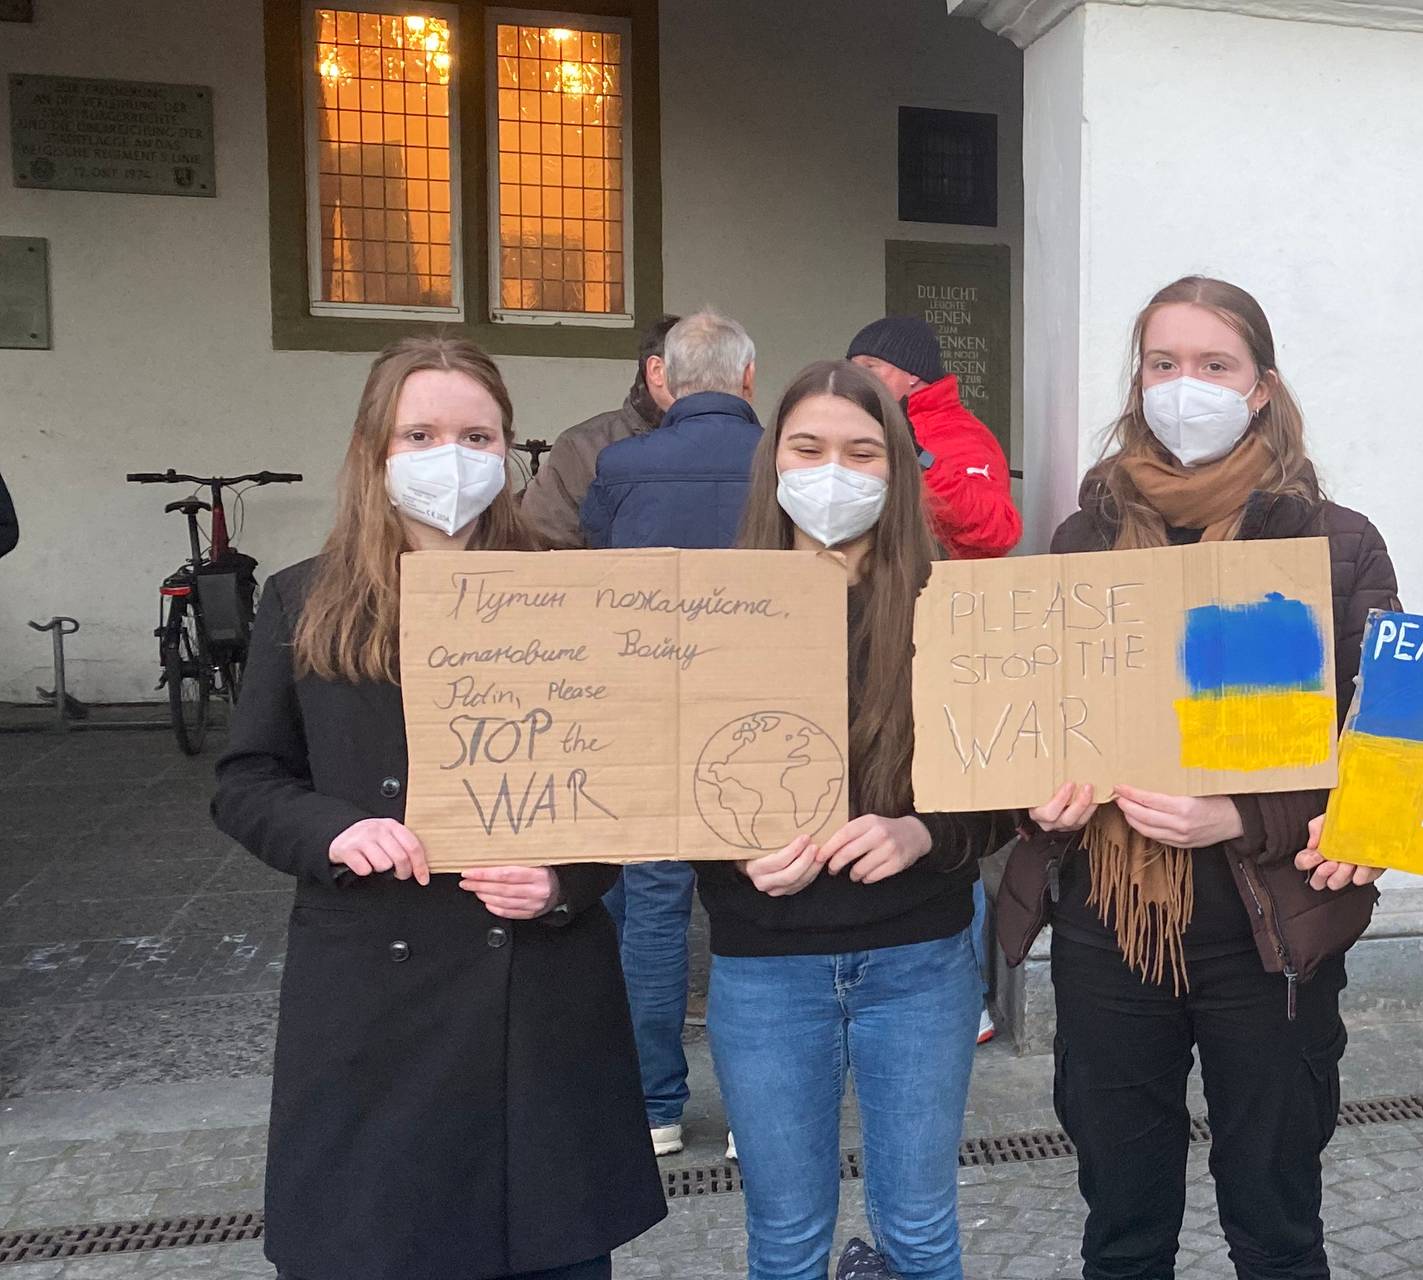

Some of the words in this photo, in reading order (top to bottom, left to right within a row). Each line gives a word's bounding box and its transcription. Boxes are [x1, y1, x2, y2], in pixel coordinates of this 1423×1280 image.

[925, 309, 972, 325] DENEN
[447, 569, 567, 623] Путин
[950, 581, 1145, 635] PLEASE
[950, 643, 1060, 685] STOP
[1075, 634, 1146, 680] THE
[439, 707, 553, 770] STOP
[560, 721, 614, 753] the
[943, 695, 1103, 774] WAR
[462, 767, 619, 836] WAR
